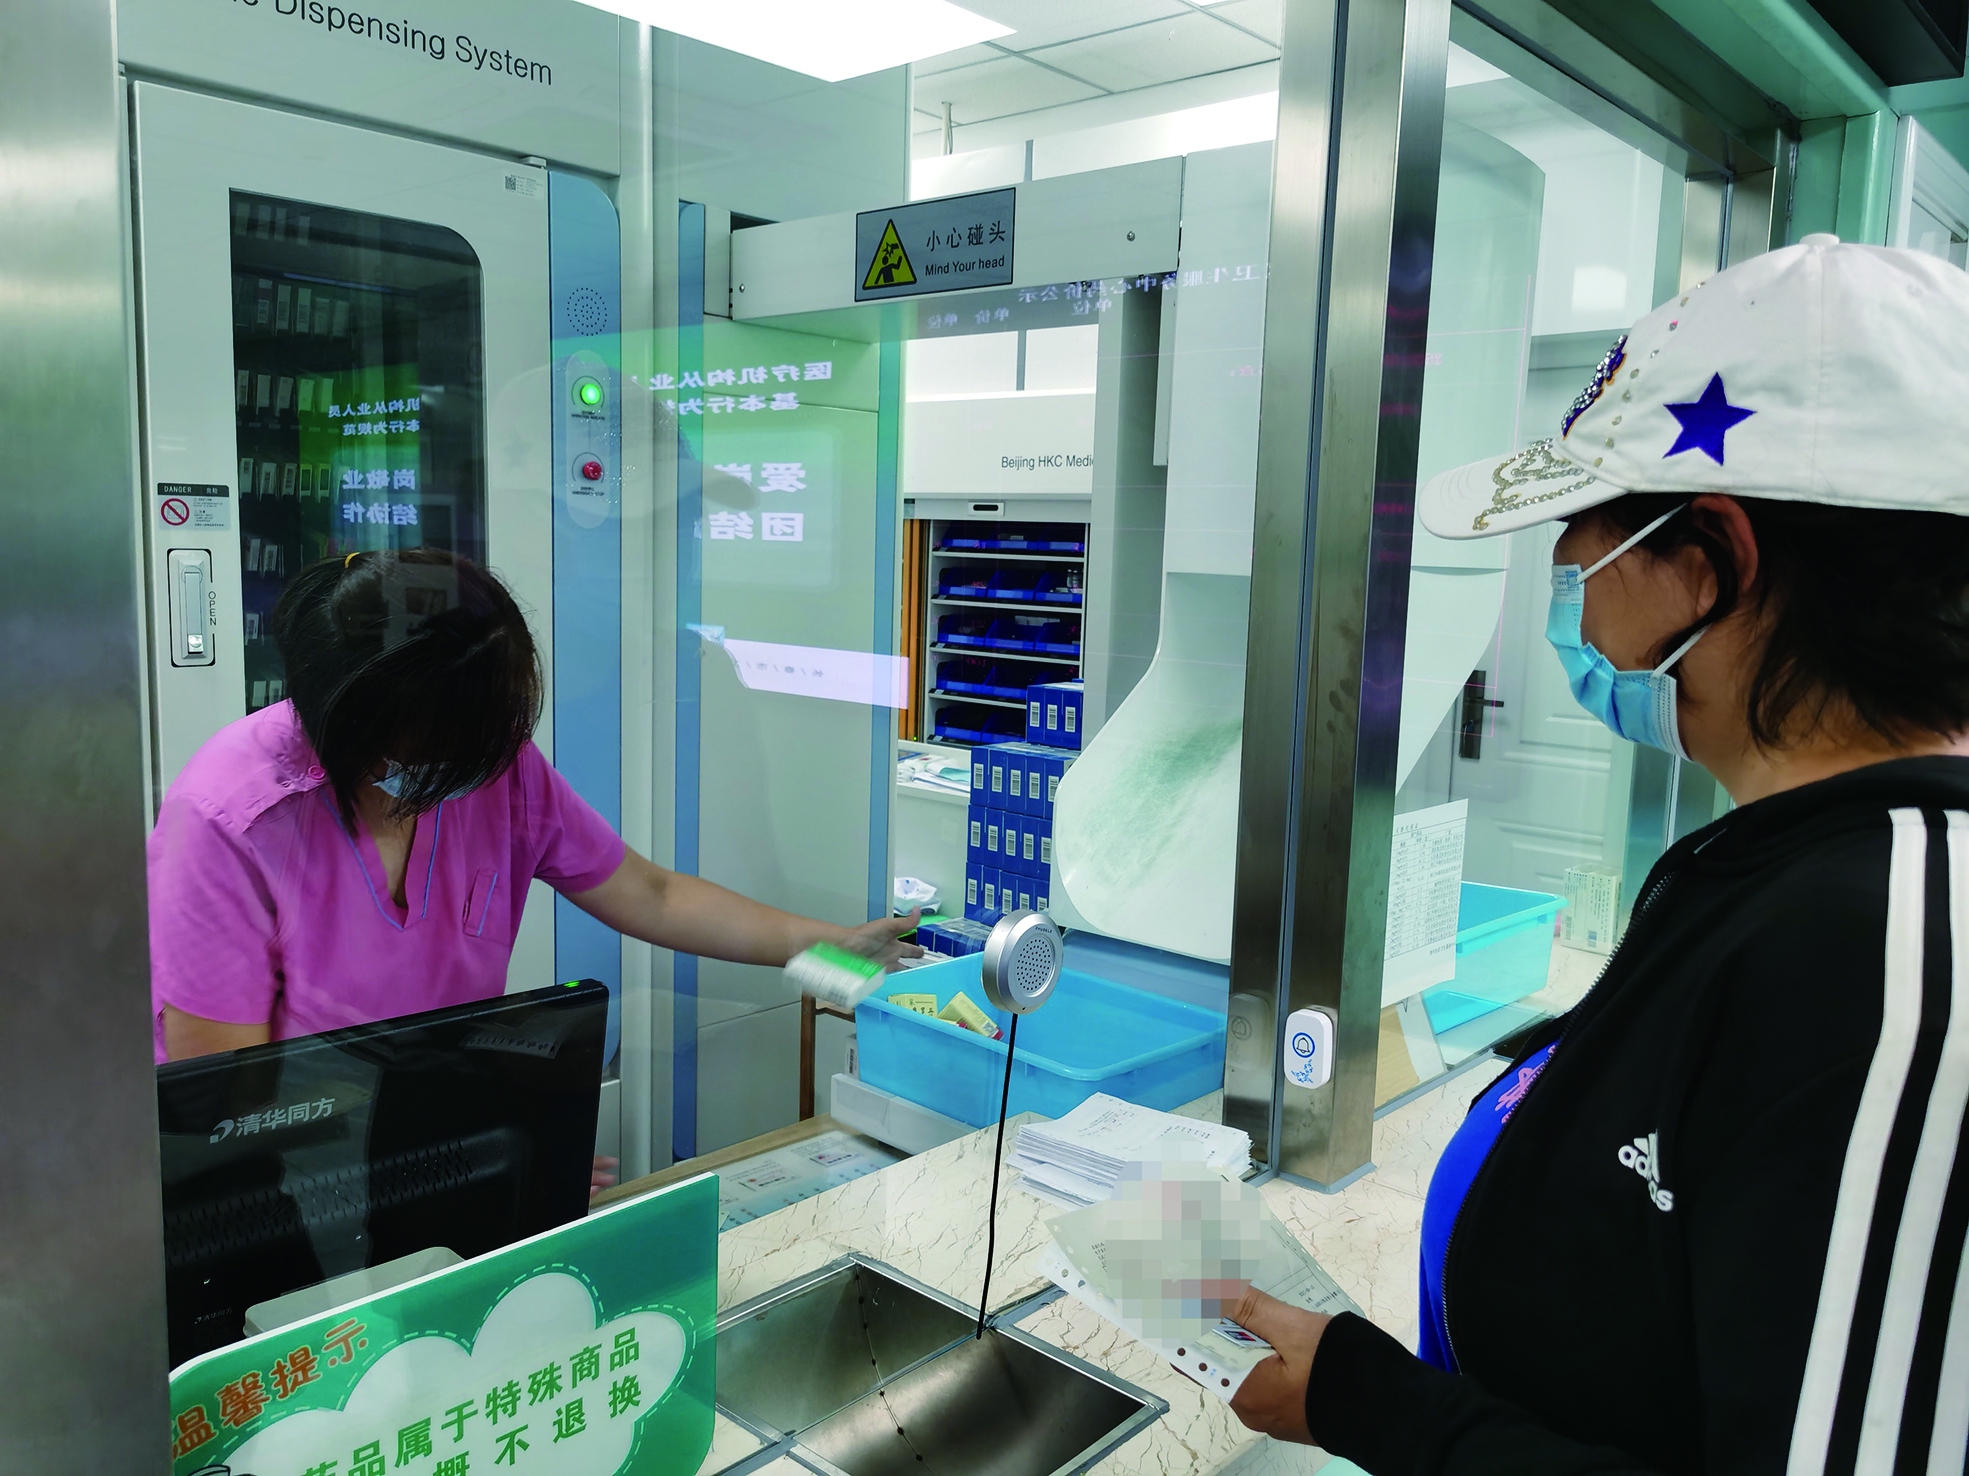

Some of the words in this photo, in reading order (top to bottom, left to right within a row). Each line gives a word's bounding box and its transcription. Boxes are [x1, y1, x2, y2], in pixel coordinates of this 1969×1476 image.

[455, 34, 552, 86] System
[925, 220, 1007, 253] 小心碰头
[925, 261, 950, 277] Mind
[952, 260, 977, 273] Your
[978, 254, 1006, 270] head
[1001, 456, 1036, 471] Beijing
[1037, 454, 1063, 468] HKC
[163, 485, 192, 494] DANGER
[208, 590, 217, 626] OPEN
[236, 1097, 336, 1138] 清华同方
[172, 1317, 369, 1460] 温馨提示
